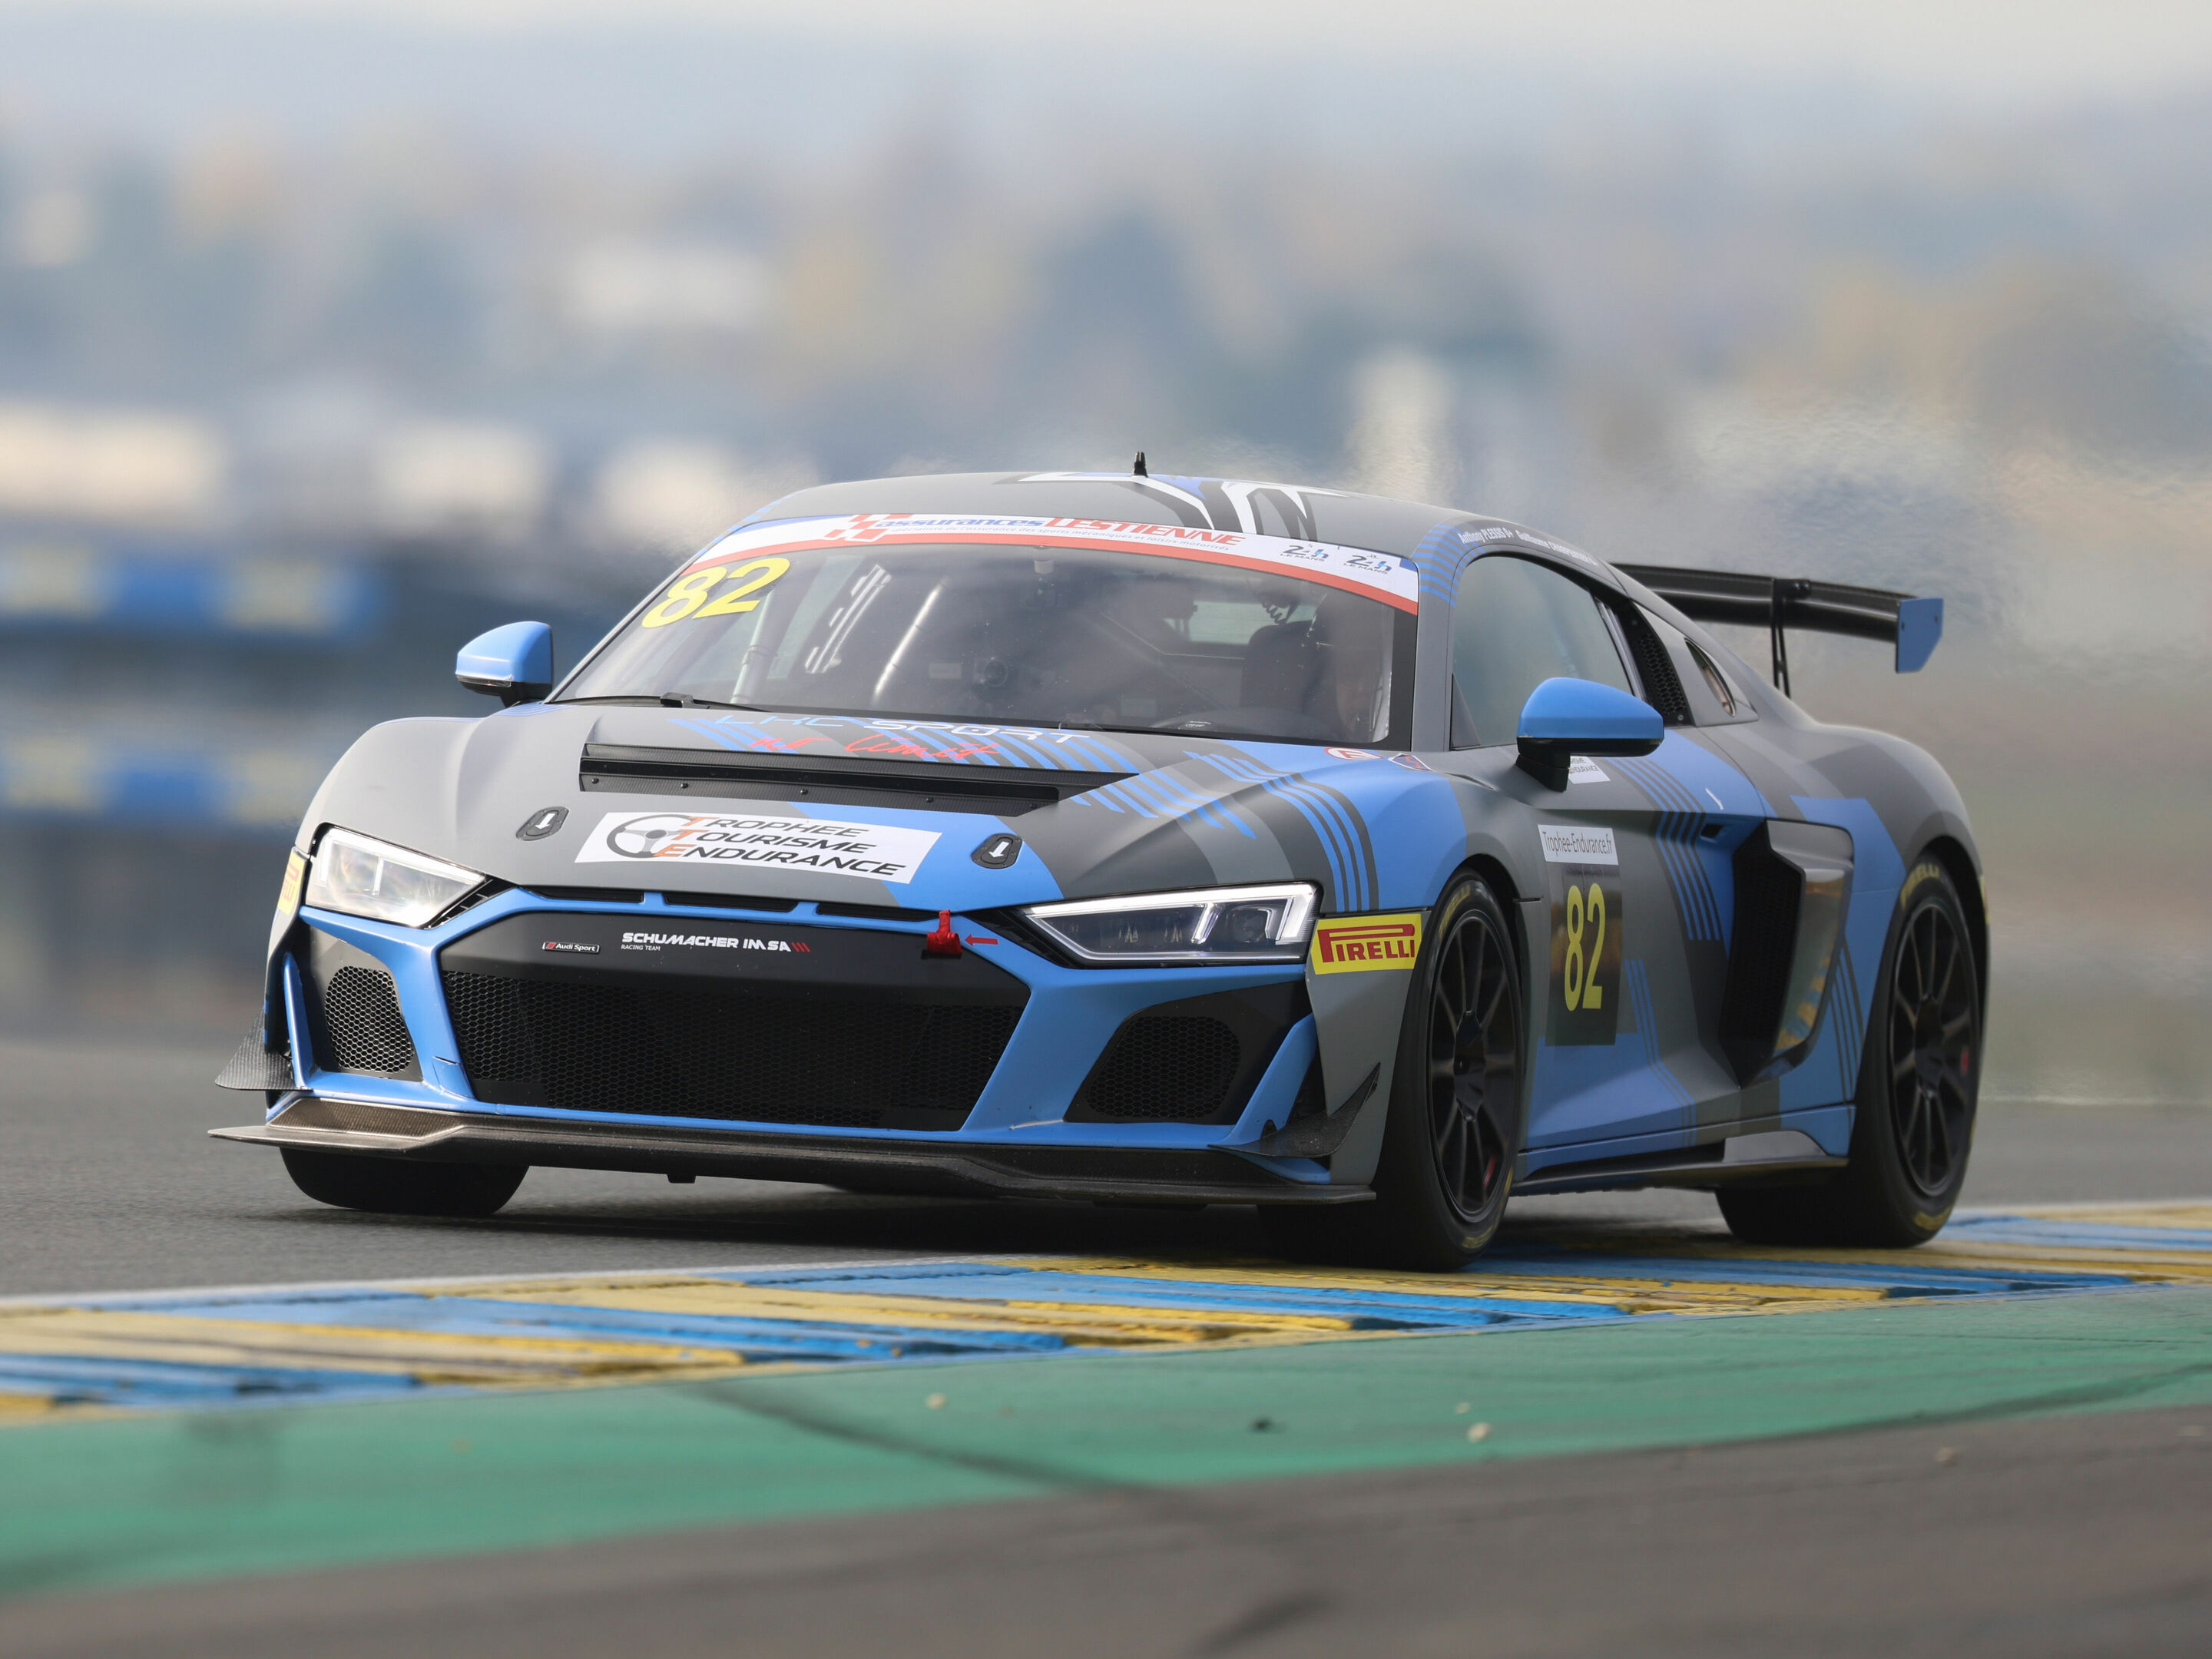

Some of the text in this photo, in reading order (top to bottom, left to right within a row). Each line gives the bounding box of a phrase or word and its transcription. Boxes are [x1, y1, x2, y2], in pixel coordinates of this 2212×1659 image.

[875, 517, 1246, 546] assurances LESTIENNE
[1147, 535, 1178, 545] loisirs
[1359, 565, 1389, 575] MANS
[641, 557, 791, 628] 82
[863, 720, 1091, 743] SPORT
[682, 816, 870, 838] TROPHEE
[674, 829, 878, 854] TOURISME
[1542, 831, 1613, 858] Trophee-Endurance.fr
[653, 843, 907, 876] ENDURANCE
[621, 932, 739, 949] SCHUMACHER
[1316, 923, 1416, 963] PIRELLI
[1564, 882, 1606, 1012] 82
